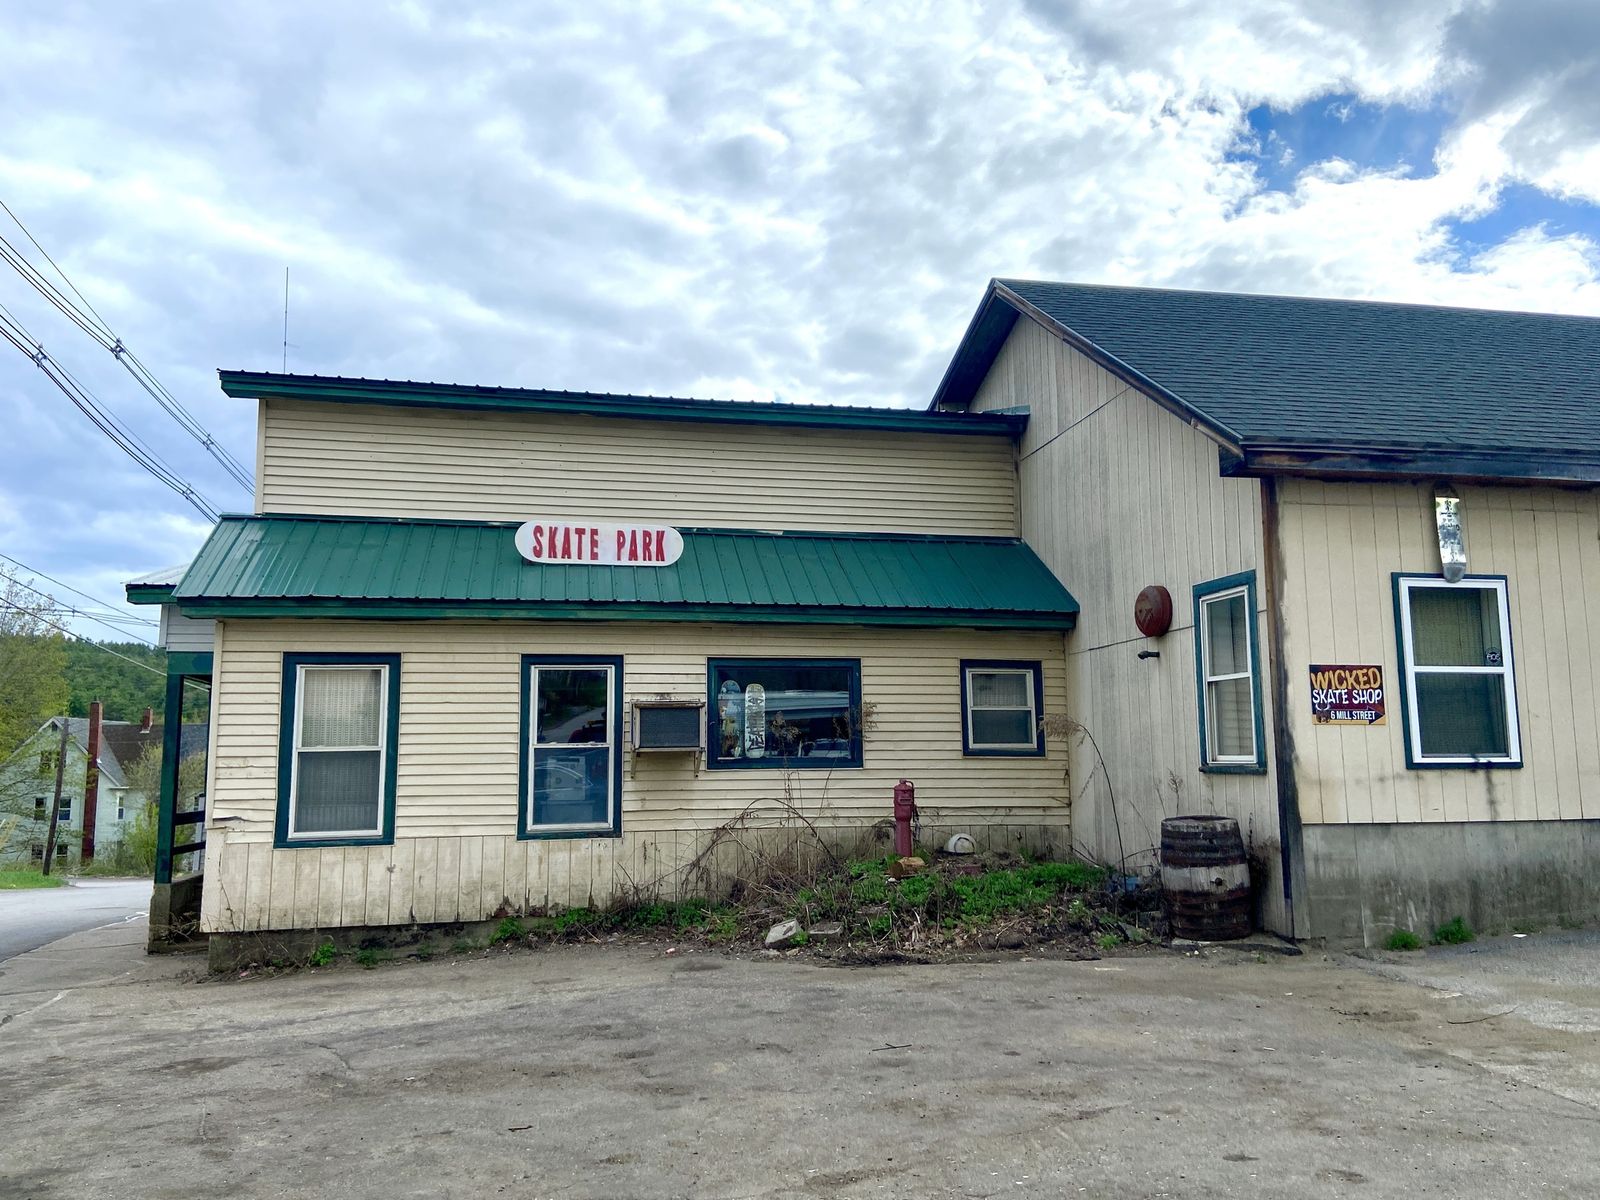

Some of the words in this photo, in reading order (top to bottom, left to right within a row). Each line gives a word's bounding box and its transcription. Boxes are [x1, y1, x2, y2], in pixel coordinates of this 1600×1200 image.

[533, 525, 599, 561] SKATE
[617, 529, 665, 561] PARK
[1311, 668, 1381, 690] WICKED
[1312, 689, 1349, 704] SKATE
[1352, 689, 1382, 704] SHOP
[1330, 710, 1336, 719] 6
[1337, 710, 1352, 720] MILL
[1352, 710, 1376, 720] STREET
